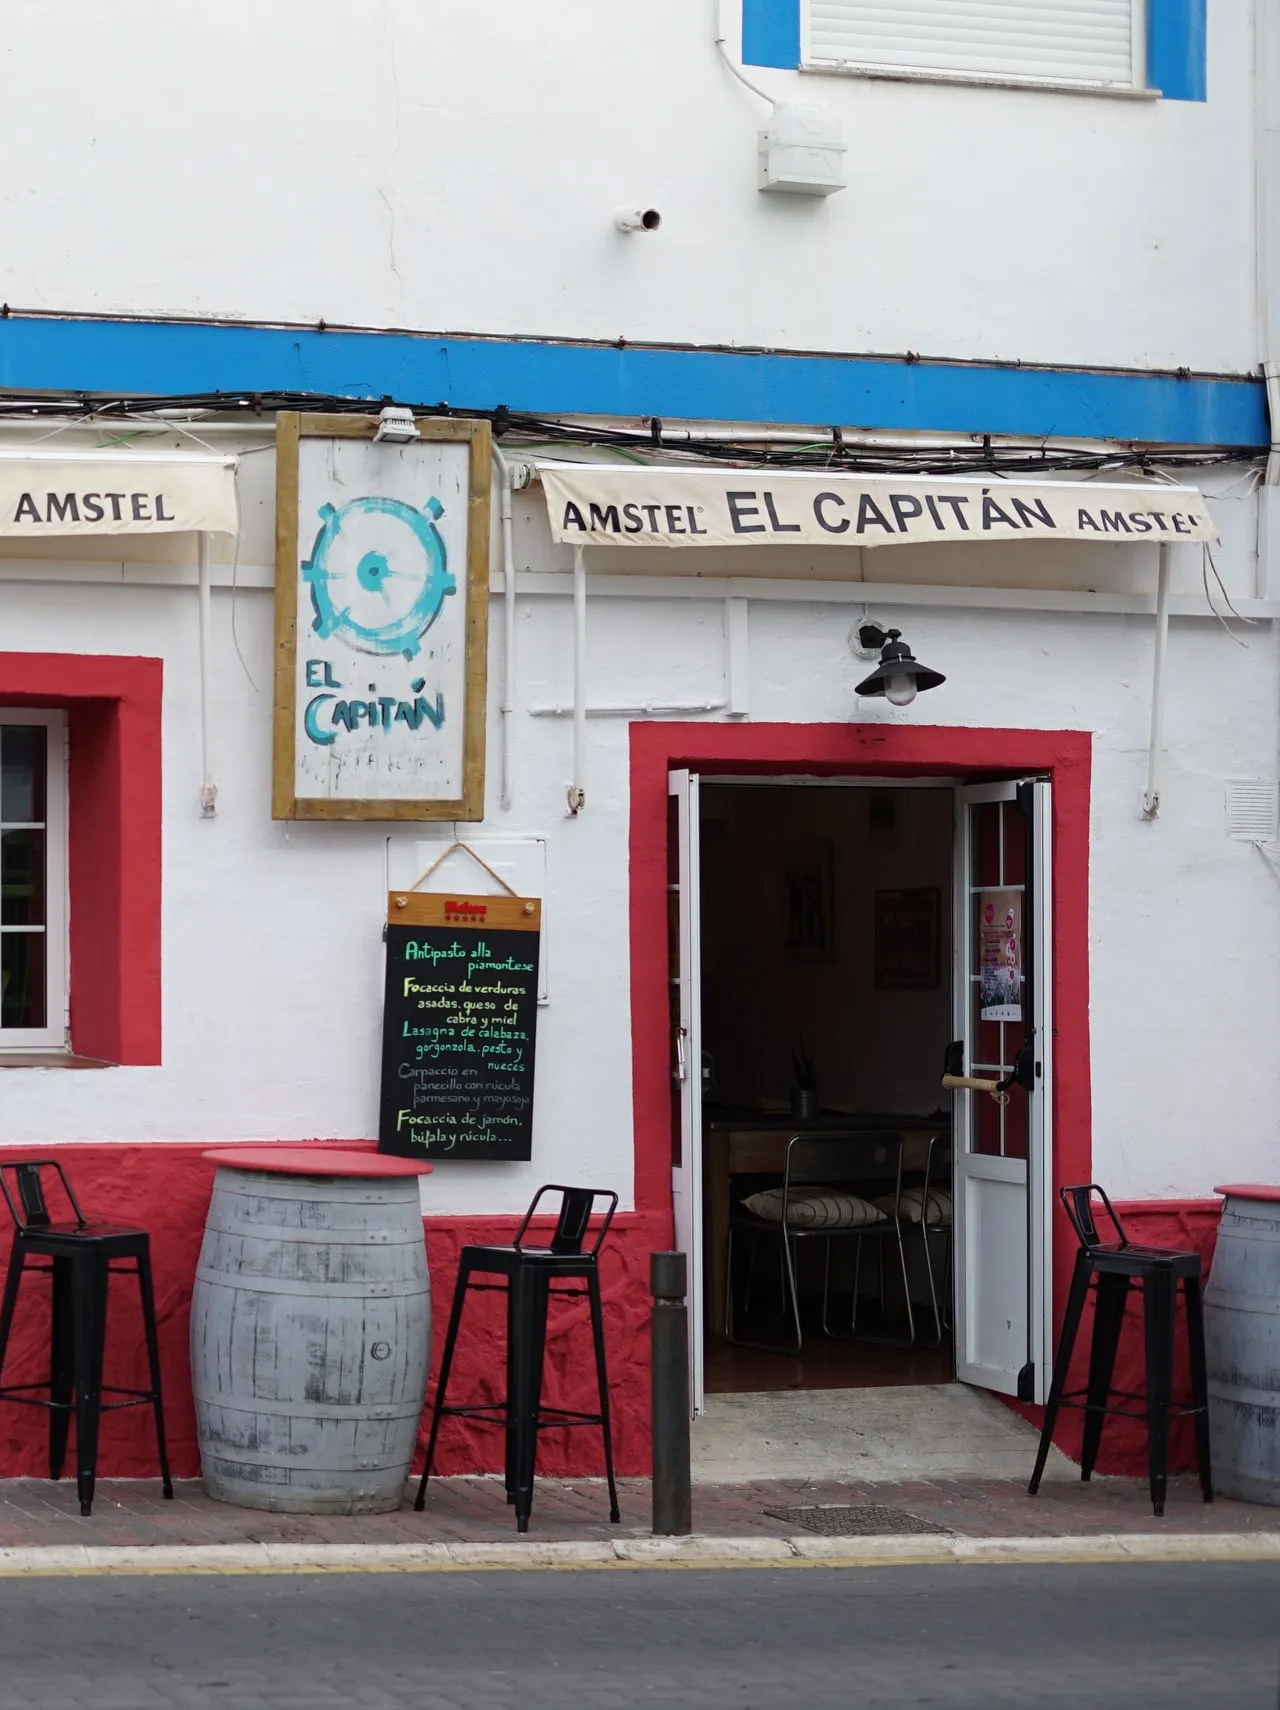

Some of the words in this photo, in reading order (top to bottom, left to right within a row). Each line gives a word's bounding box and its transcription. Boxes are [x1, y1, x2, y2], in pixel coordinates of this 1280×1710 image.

[13, 492, 176, 522] AMSTEL
[725, 491, 802, 534] EL
[813, 488, 1057, 534] CAPITÁN
[306, 659, 344, 688] EL
[405, 940, 466, 967] Antipasto
[470, 941, 492, 958] alla
[467, 956, 535, 979] piamontese
[403, 977, 456, 998] Focaccia
[458, 980, 473, 993] de
[474, 980, 527, 995] verduras
[463, 999, 496, 1015] queso
[503, 998, 519, 1011] de
[402, 1020, 456, 1043] Lasagna
[460, 1026, 476, 1037] de
[446, 1012, 478, 1025] cabra
[481, 1017, 489, 1029] y
[491, 1013, 517, 1026] miel
[481, 1040, 512, 1058] pesto
[514, 1048, 524, 1062] y
[397, 1062, 459, 1083] Carpaccio
[461, 1069, 478, 1077] en
[487, 1062, 527, 1072] nueces
[413, 1077, 462, 1096] panecillo
[464, 1081, 484, 1091] con
[412, 1095, 471, 1110] parmesano
[472, 1097, 482, 1112] y
[396, 1108, 457, 1132] Focaccia
[460, 1112, 476, 1125] de
[410, 1128, 447, 1149] búfala
[444, 1133, 457, 1151] y
